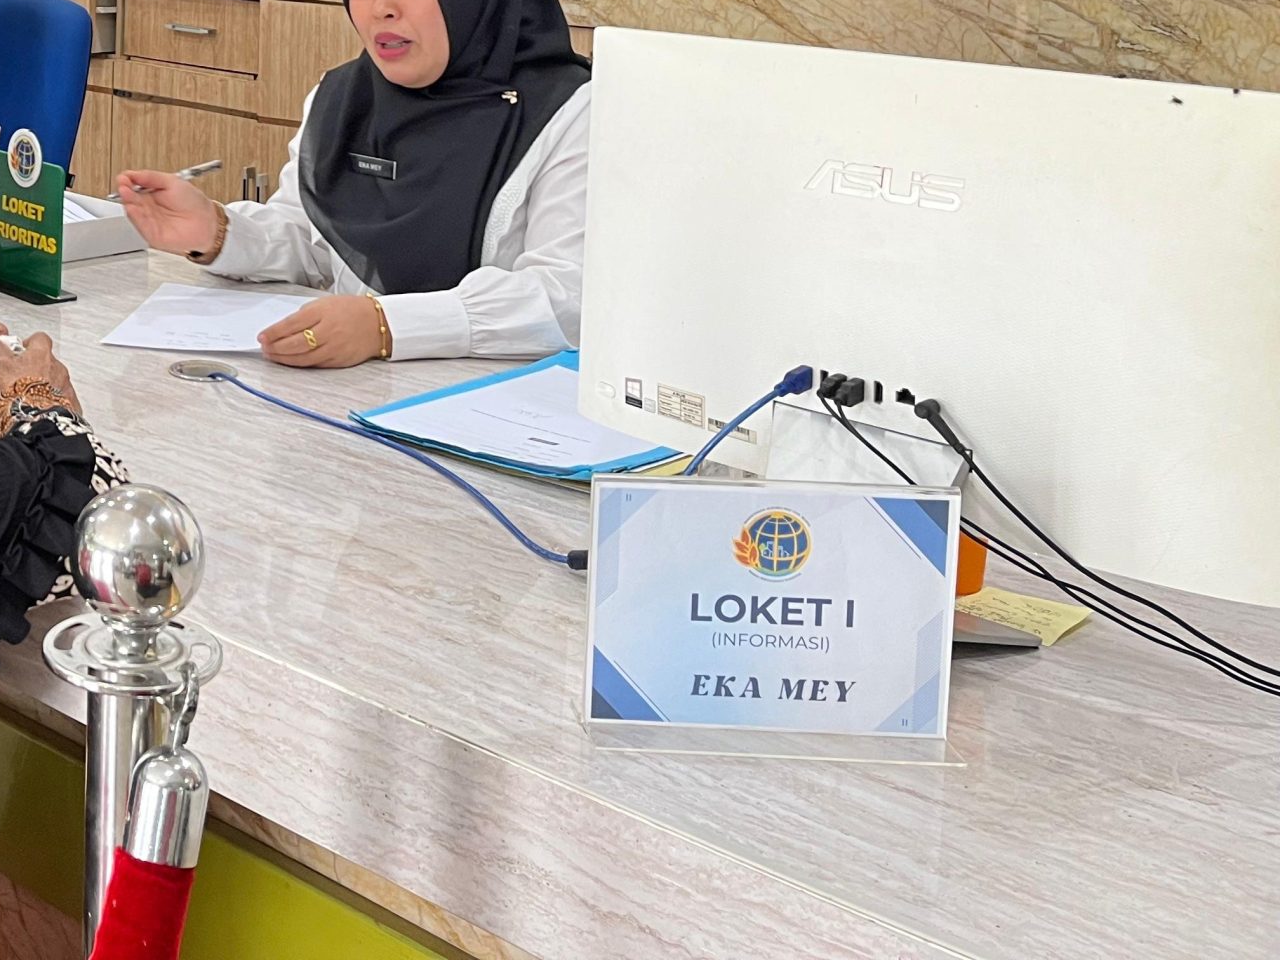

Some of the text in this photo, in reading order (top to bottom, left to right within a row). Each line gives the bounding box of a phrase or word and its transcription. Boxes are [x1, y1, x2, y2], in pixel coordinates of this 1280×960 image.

[803, 158, 966, 213] ASUS
[1, 194, 46, 222] LOKET
[690, 592, 855, 628] LOKET I
[711, 632, 831, 654] (INFORMASI)
[690, 673, 857, 703] EKA MEY
